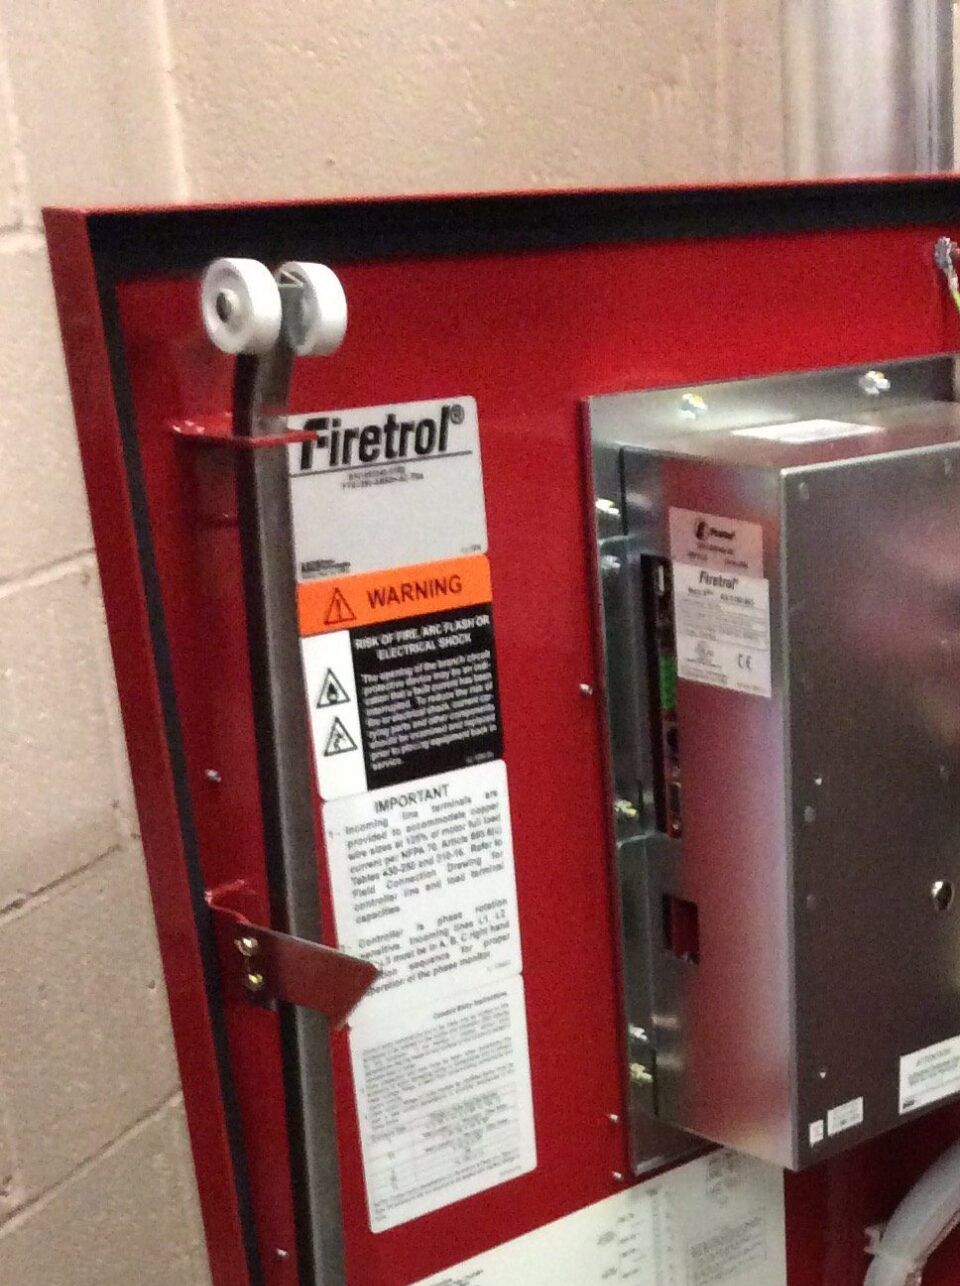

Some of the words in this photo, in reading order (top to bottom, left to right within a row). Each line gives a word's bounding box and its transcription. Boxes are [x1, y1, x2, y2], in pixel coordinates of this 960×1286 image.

[366, 574, 463, 609] WARNING
[355, 637, 379, 650] RISK
[380, 633, 394, 645] OF
[422, 623, 442, 637] ARC
[442, 618, 475, 634] FLASH
[475, 614, 490, 626] OR
[376, 640, 436, 660] ELECTRICAL
[438, 632, 472, 649] SHOCK
[374, 784, 449, 813] IMPORTANT
[345, 818, 389, 835] Incoming
[347, 831, 387, 849] provided
[406, 810, 466, 833] accommodate
[386, 869, 436, 890] Connection
[447, 857, 482, 872] Drawing
[358, 929, 403, 948] Controller
